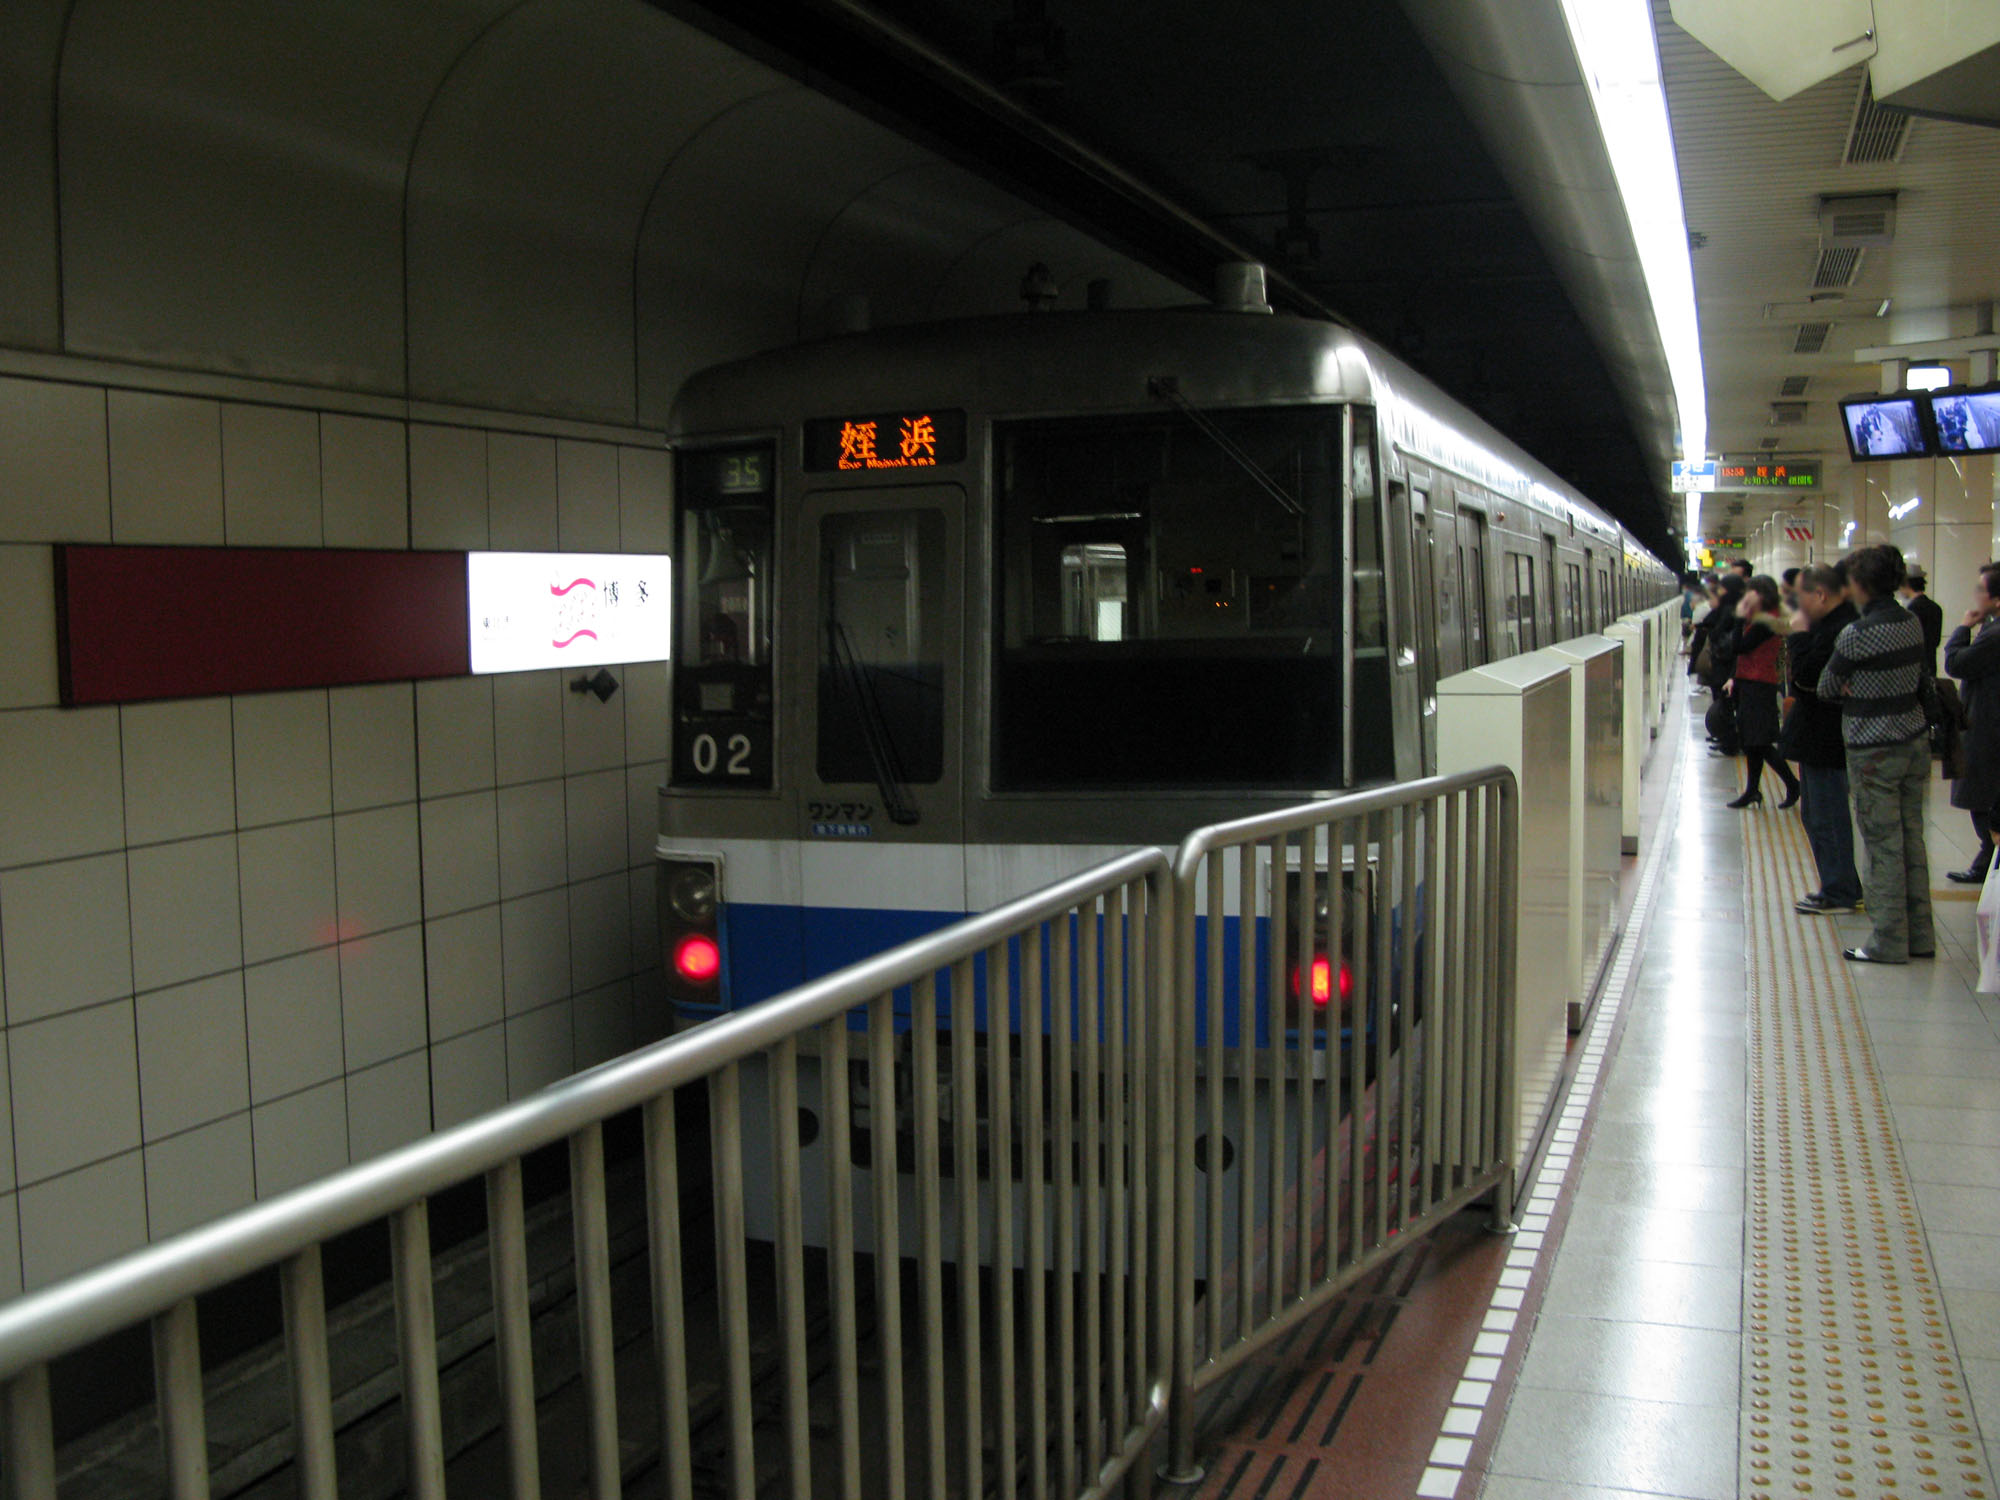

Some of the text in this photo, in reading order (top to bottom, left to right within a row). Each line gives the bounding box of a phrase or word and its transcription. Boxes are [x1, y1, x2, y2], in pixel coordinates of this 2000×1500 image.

[839, 415, 937, 459] 姪浜
[692, 733, 752, 776] 02
[808, 802, 873, 821] ワンマン
